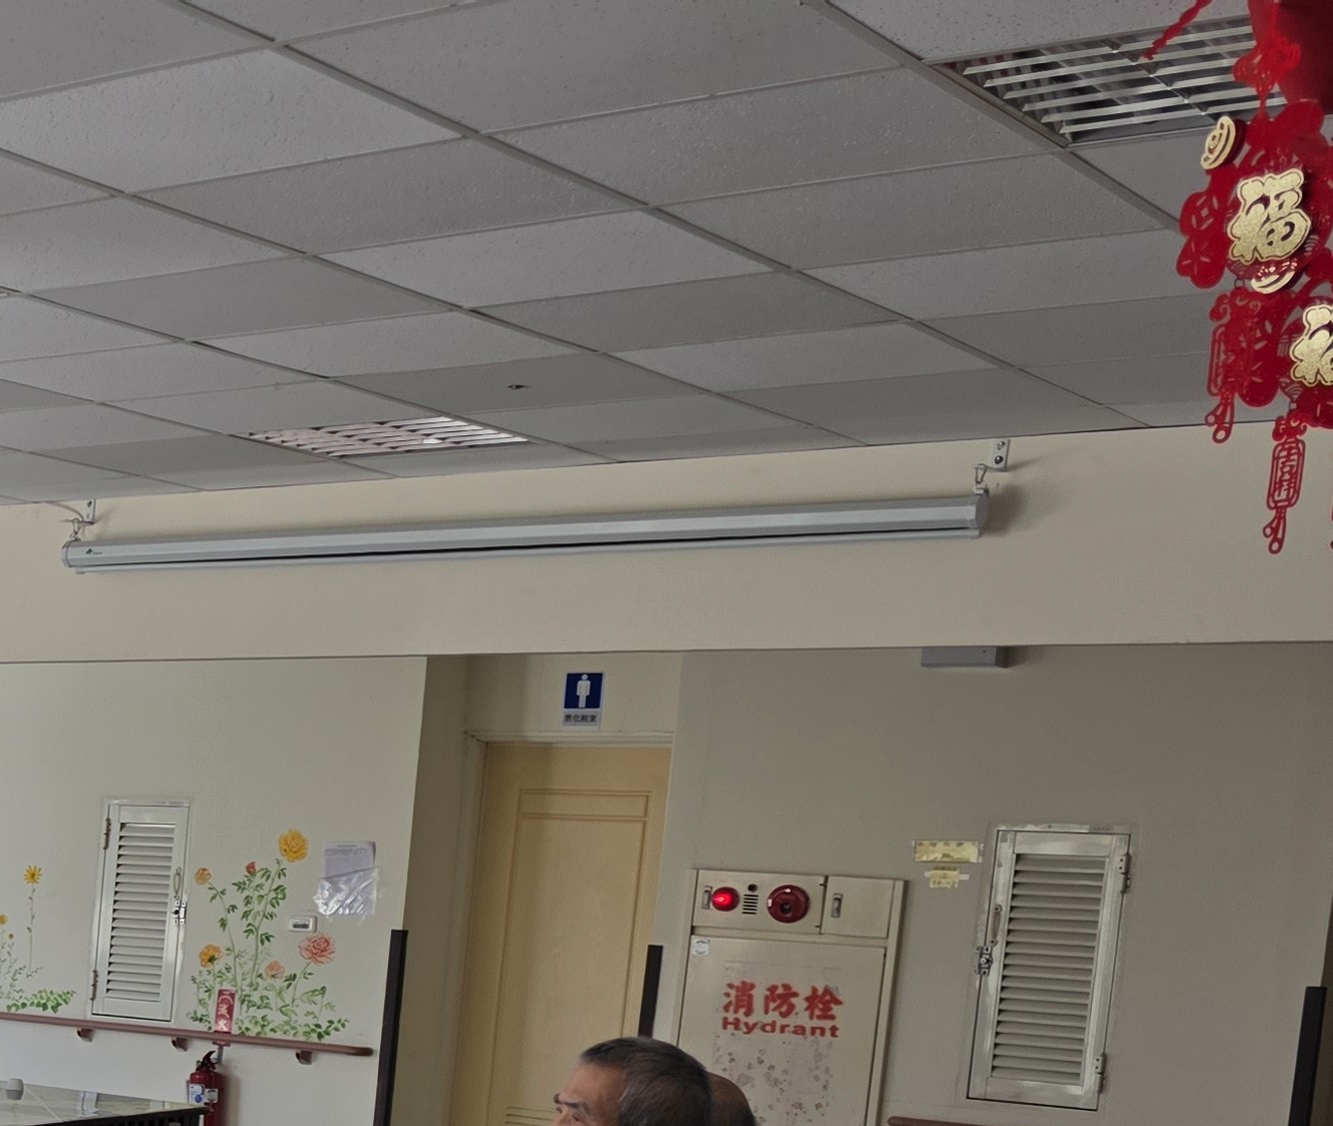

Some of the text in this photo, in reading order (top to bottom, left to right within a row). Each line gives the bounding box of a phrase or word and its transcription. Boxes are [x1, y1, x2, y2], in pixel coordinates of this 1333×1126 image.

[1227, 168, 1311, 265] 福
[722, 980, 844, 1021] 消防栓
[721, 1016, 840, 1038] Hydrant
